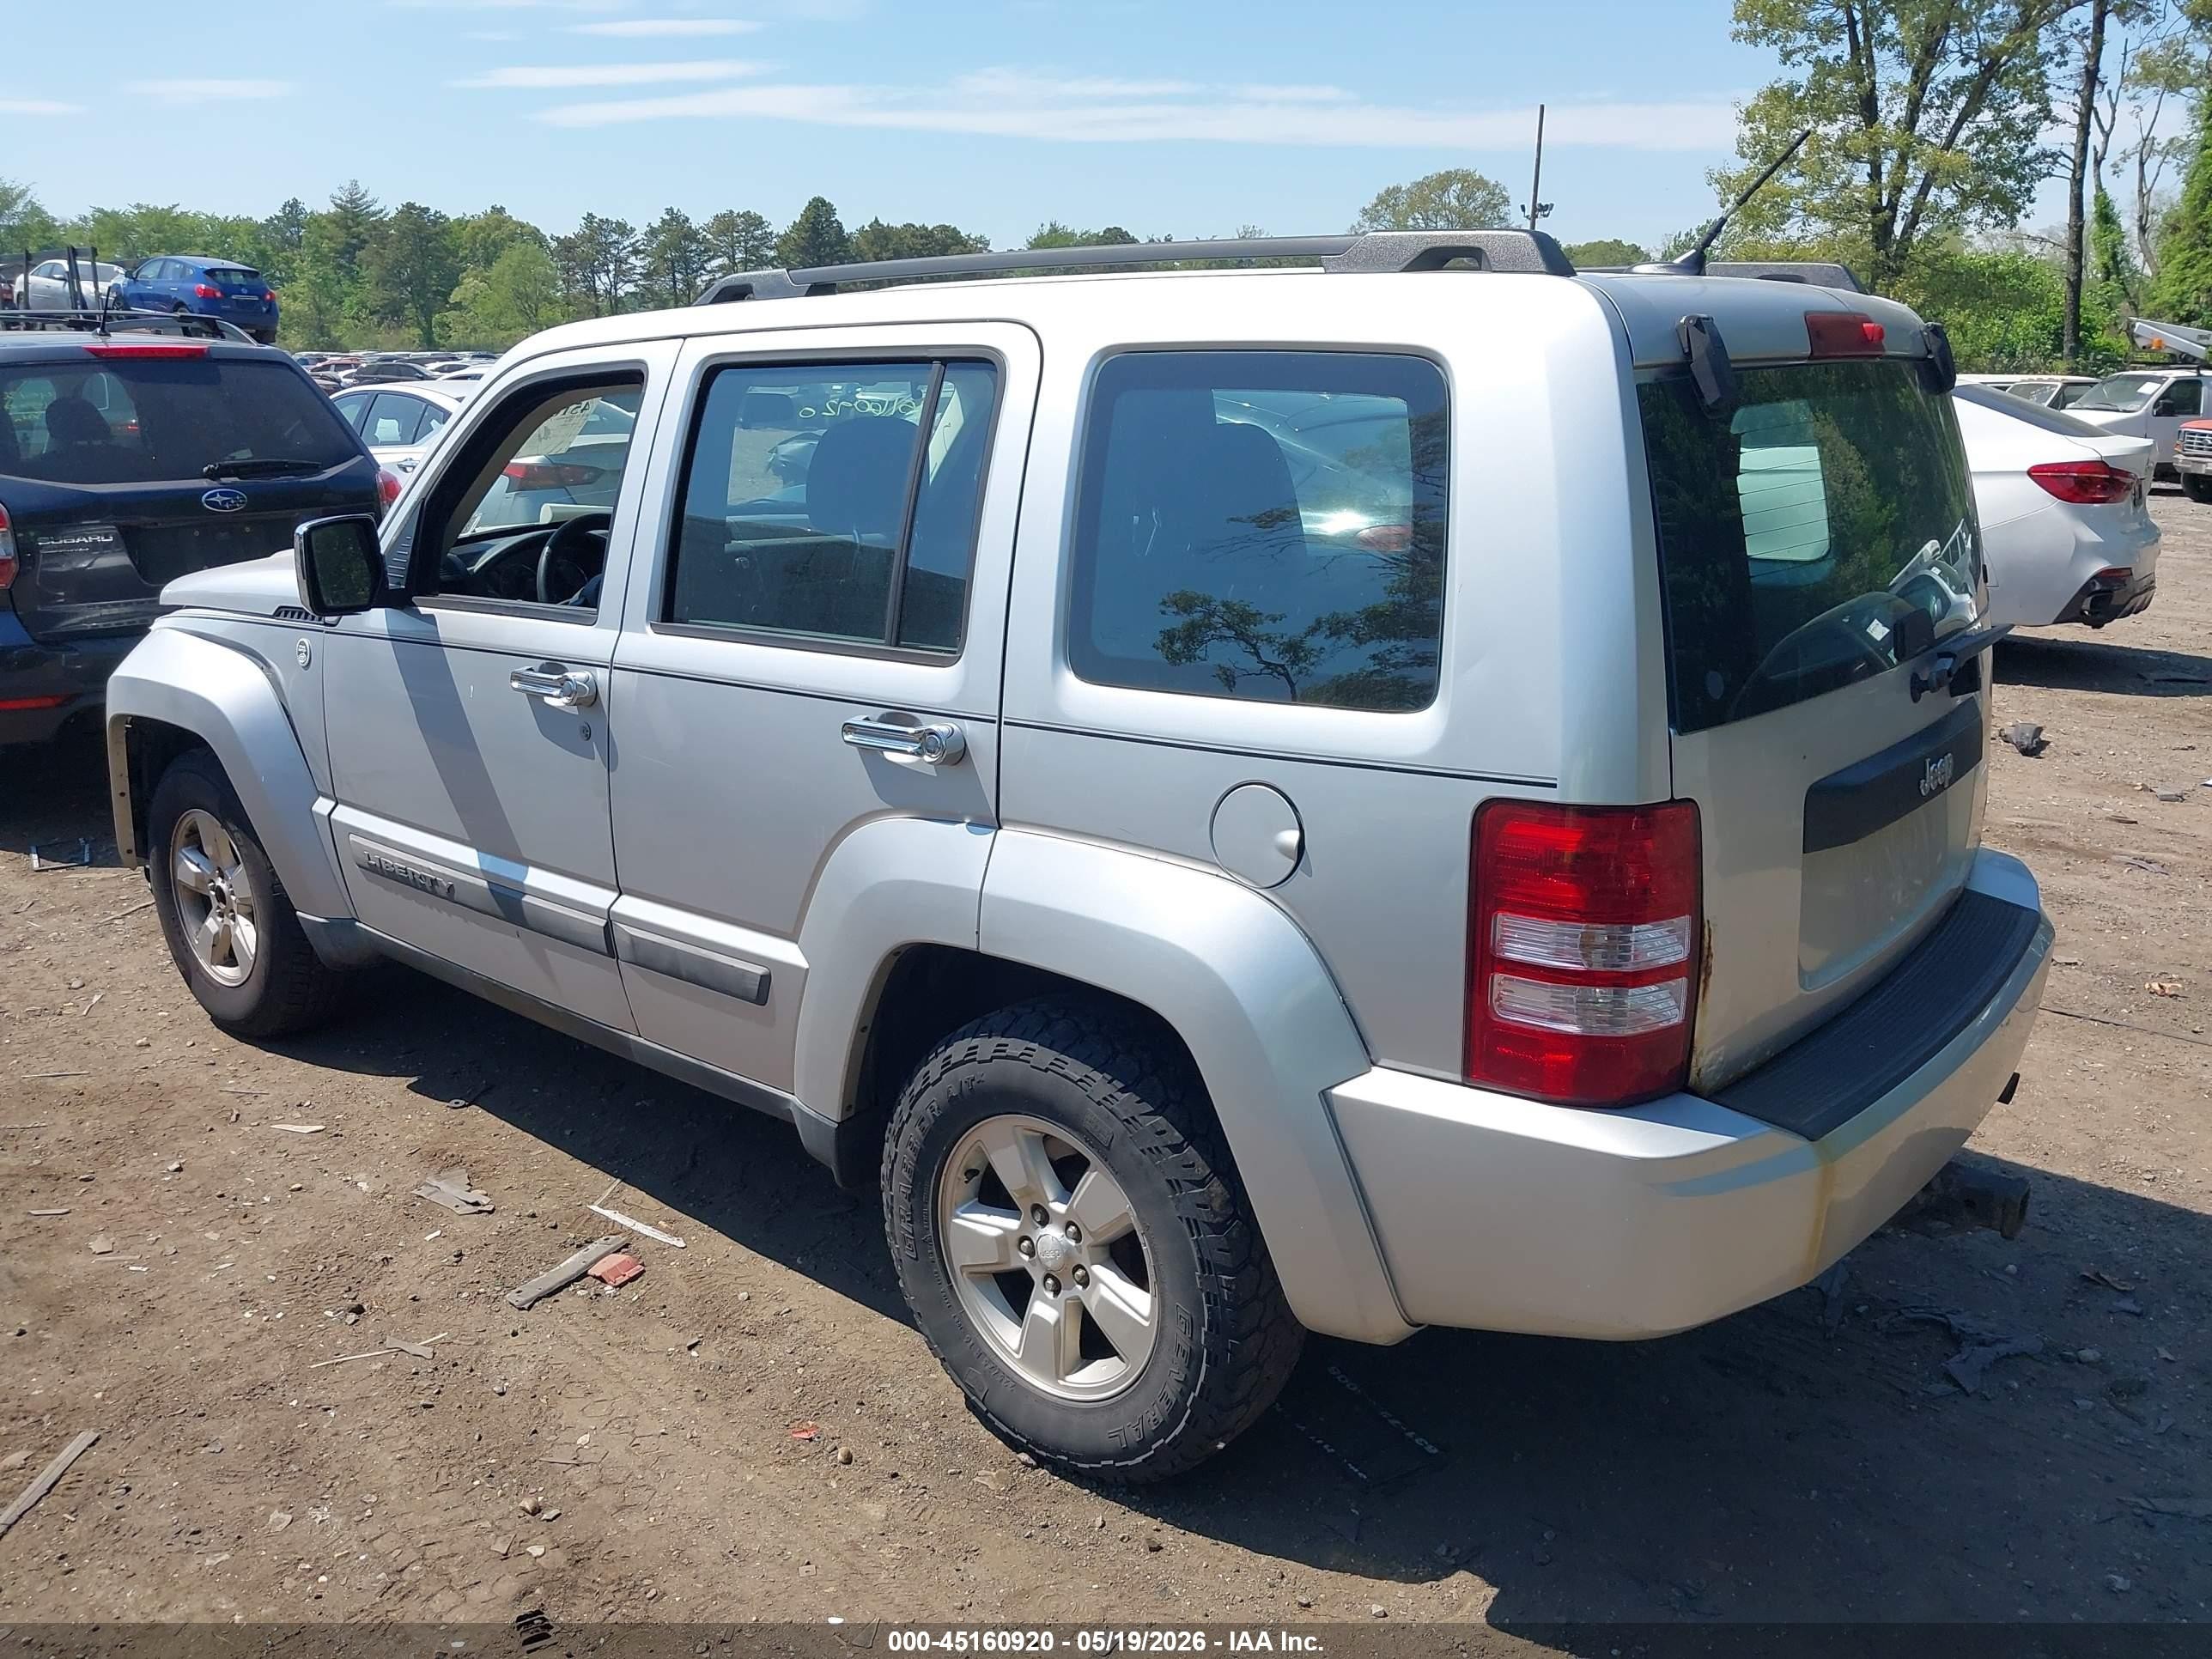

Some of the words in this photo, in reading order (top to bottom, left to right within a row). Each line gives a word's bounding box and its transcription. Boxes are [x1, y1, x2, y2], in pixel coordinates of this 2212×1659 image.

[37, 535, 113, 545] SUBARU
[1919, 752, 1953, 797] Jeep
[363, 850, 456, 898] LIBERTY
[899, 1098, 943, 1261] GRABBER
[1108, 1302, 1194, 1449] GENERAL
